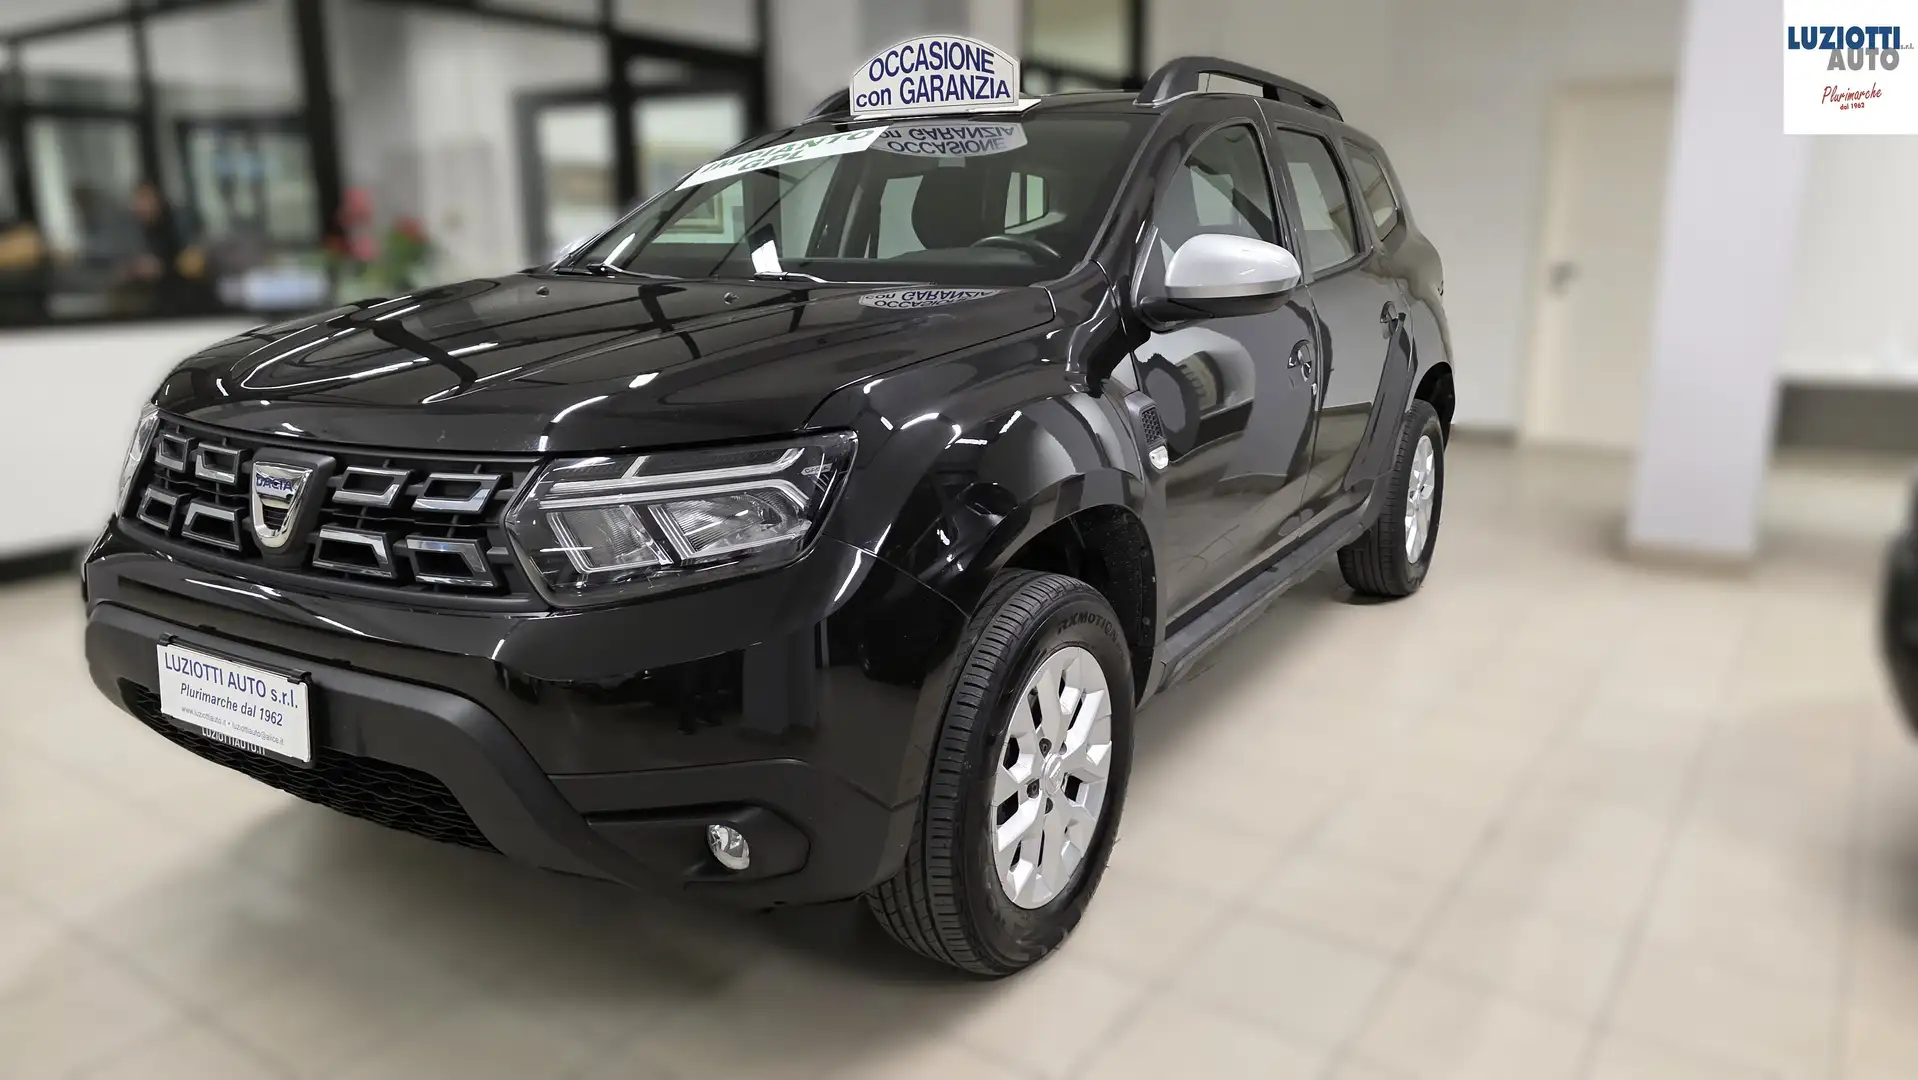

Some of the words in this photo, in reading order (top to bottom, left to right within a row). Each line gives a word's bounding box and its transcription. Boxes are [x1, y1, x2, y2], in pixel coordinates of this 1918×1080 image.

[869, 41, 995, 82] OCCASIONE
[856, 87, 892, 107] con
[900, 74, 1011, 105] GARANZIA
[700, 129, 875, 174] IMPIANTO
[738, 149, 805, 171] GPL
[256, 473, 293, 491] DACIA
[164, 652, 223, 685] LUZIOTTI
[228, 671, 266, 697] AUTO
[271, 689, 298, 708] s.r.l.
[180, 683, 238, 711] Plurimarche
[241, 702, 256, 718] dal
[260, 708, 283, 726] 1962
